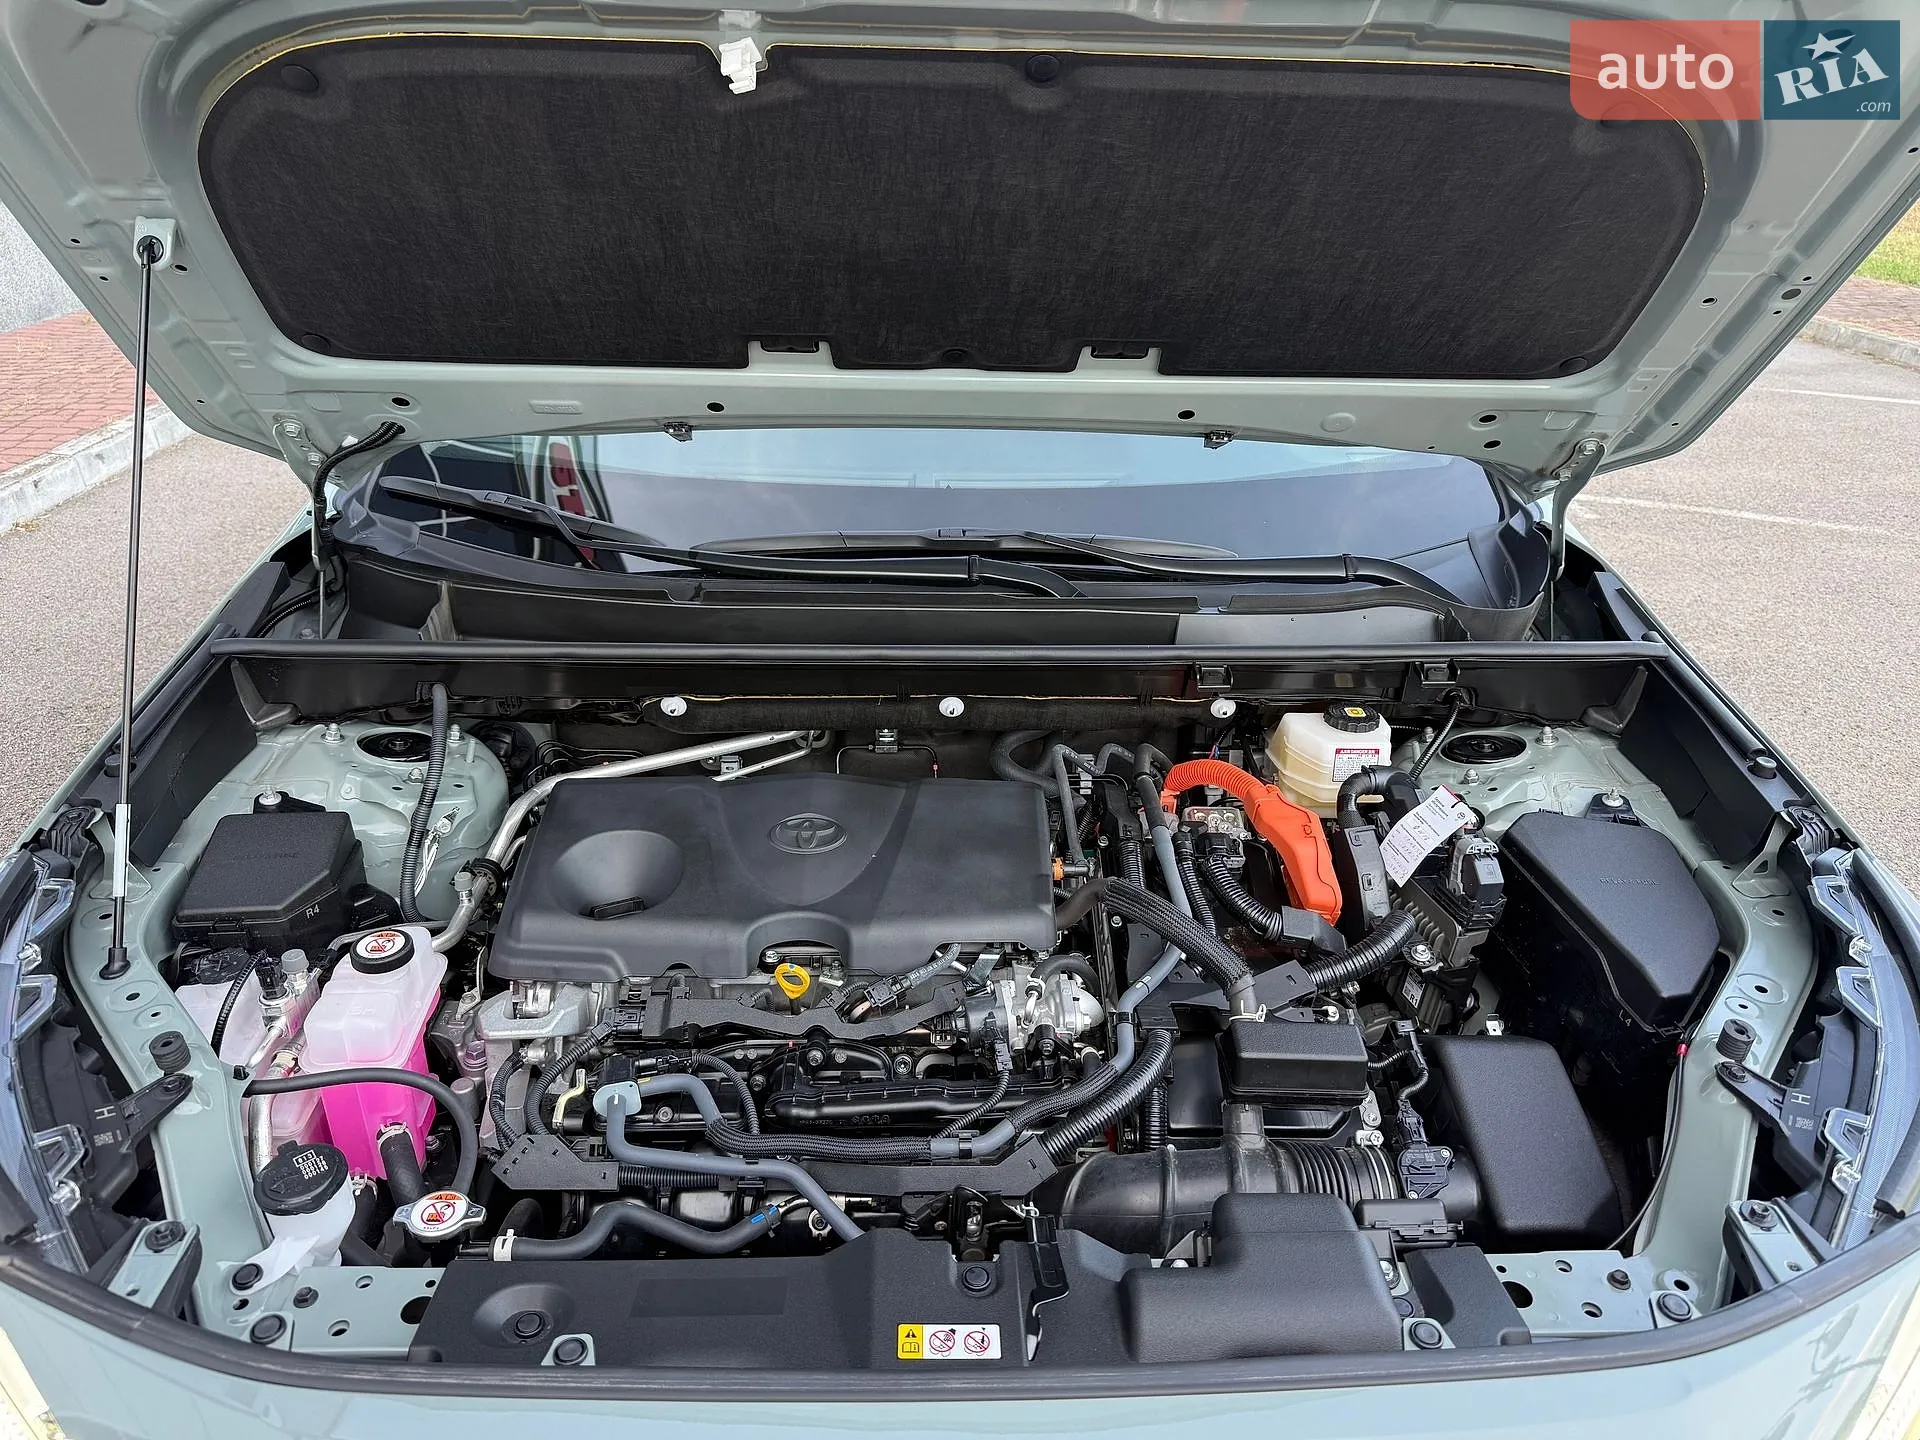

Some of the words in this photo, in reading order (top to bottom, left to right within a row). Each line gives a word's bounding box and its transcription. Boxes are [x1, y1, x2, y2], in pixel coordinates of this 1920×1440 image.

[306, 904, 320, 919] R4
[1409, 993, 1418, 1006] R1
[1790, 1092, 1811, 1105] H
[94, 1105, 117, 1120] H
